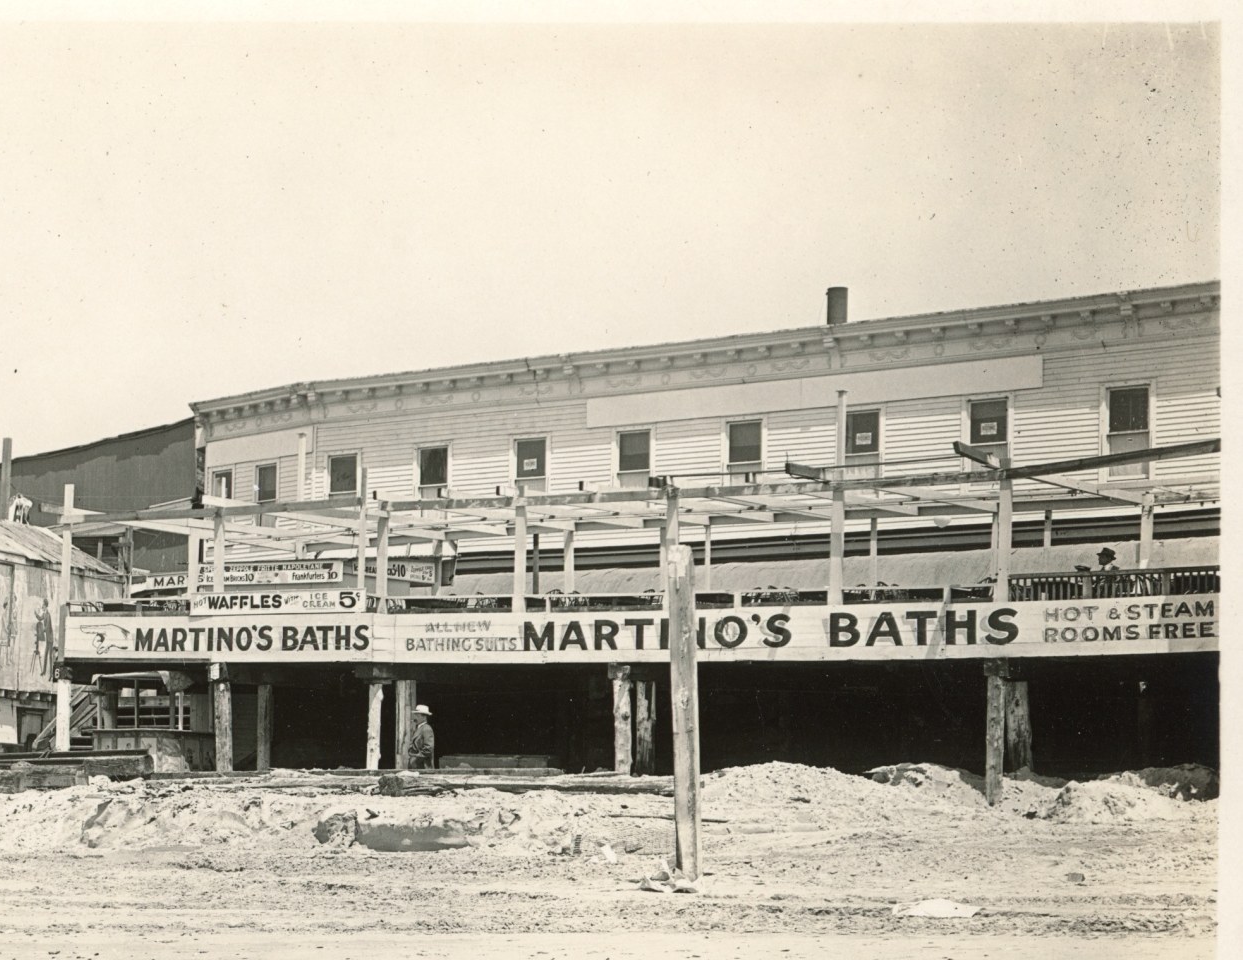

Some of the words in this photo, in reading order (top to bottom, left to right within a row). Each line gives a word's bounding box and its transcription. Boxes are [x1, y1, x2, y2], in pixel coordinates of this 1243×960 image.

[327, 571, 338, 580] 10
[208, 595, 282, 610] WAFFLES
[302, 600, 336, 608] CREAM
[1044, 606, 1099, 622] HOT
[1108, 608, 1121, 620] &
[1127, 600, 1215, 620] STEAM
[829, 607, 1019, 648] BATHS
[1044, 624, 1140, 643] ROOMS
[1148, 621, 1215, 640] FREE
[134, 625, 273, 652] MARTINO'S
[281, 625, 369, 651] BATHS
[406, 638, 472, 652] BATHING
[475, 637, 517, 651] SUITS
